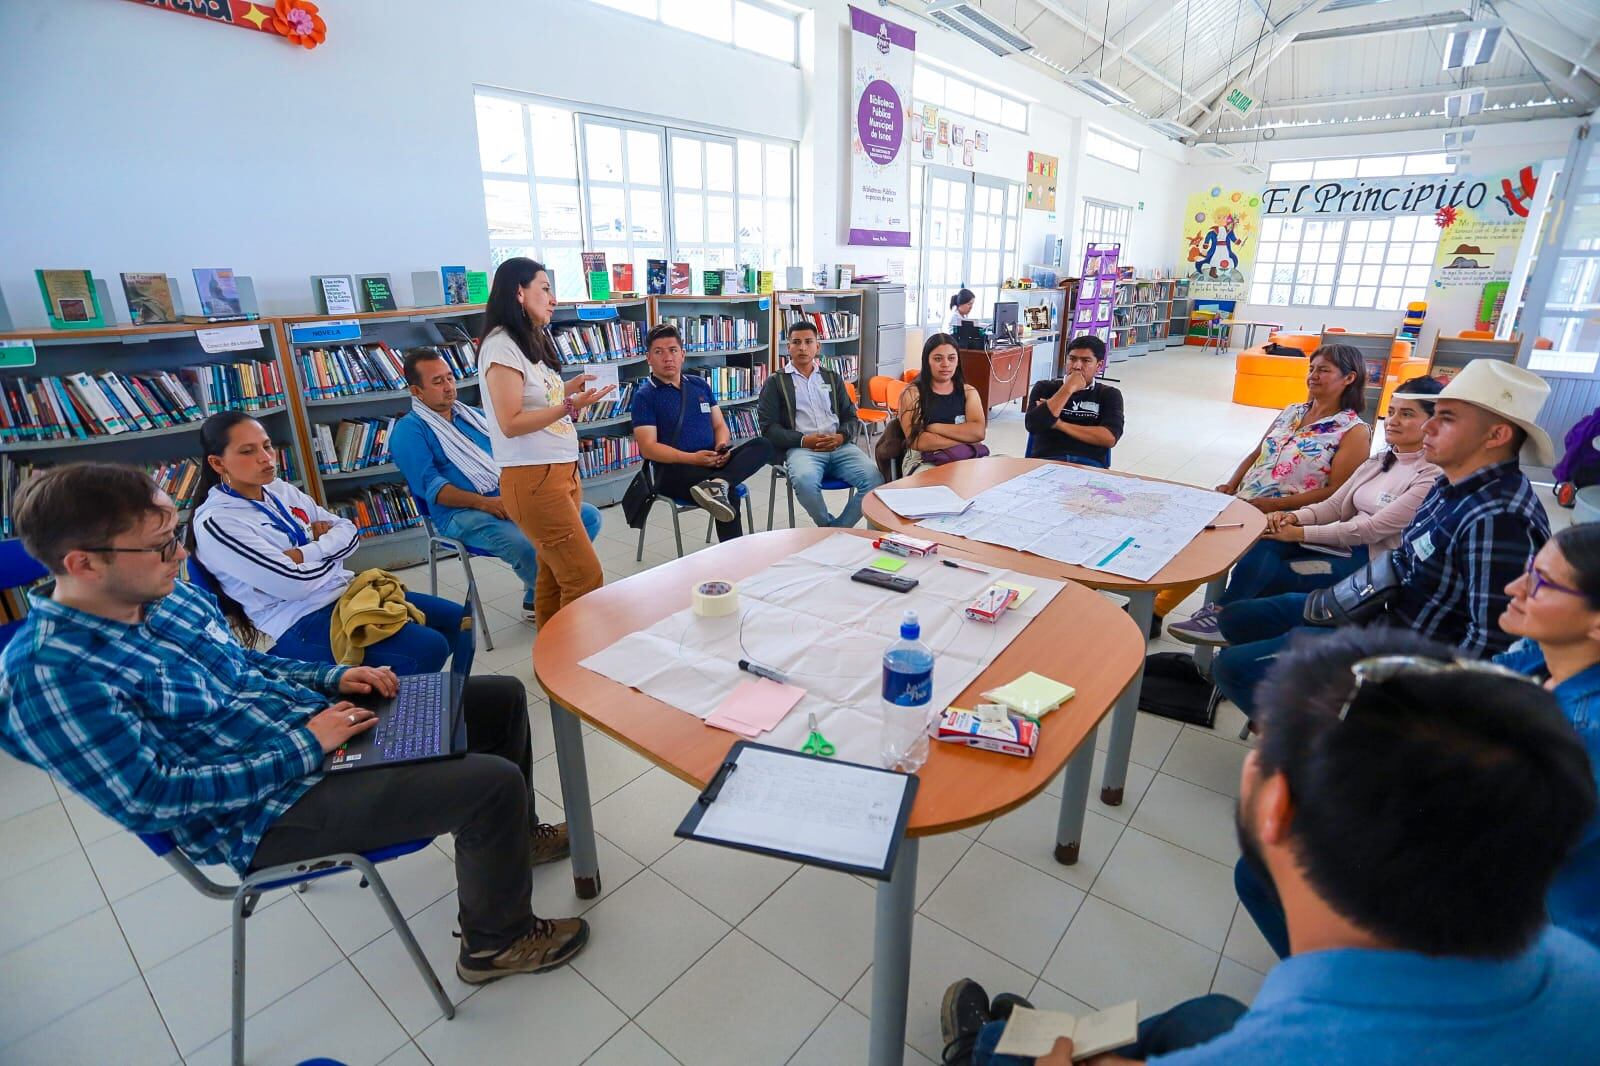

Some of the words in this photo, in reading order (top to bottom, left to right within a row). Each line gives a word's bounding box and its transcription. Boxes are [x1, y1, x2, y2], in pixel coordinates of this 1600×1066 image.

[869, 94, 895, 109] Biblioteca
[1227, 88, 1253, 112] SALIDA
[872, 106, 892, 119] Pública
[868, 116, 894, 132] Municipal
[870, 128, 878, 139] de
[1262, 183, 1310, 214] El
[1314, 177, 1487, 214] Principito
[312, 329, 342, 337] NOVELA
